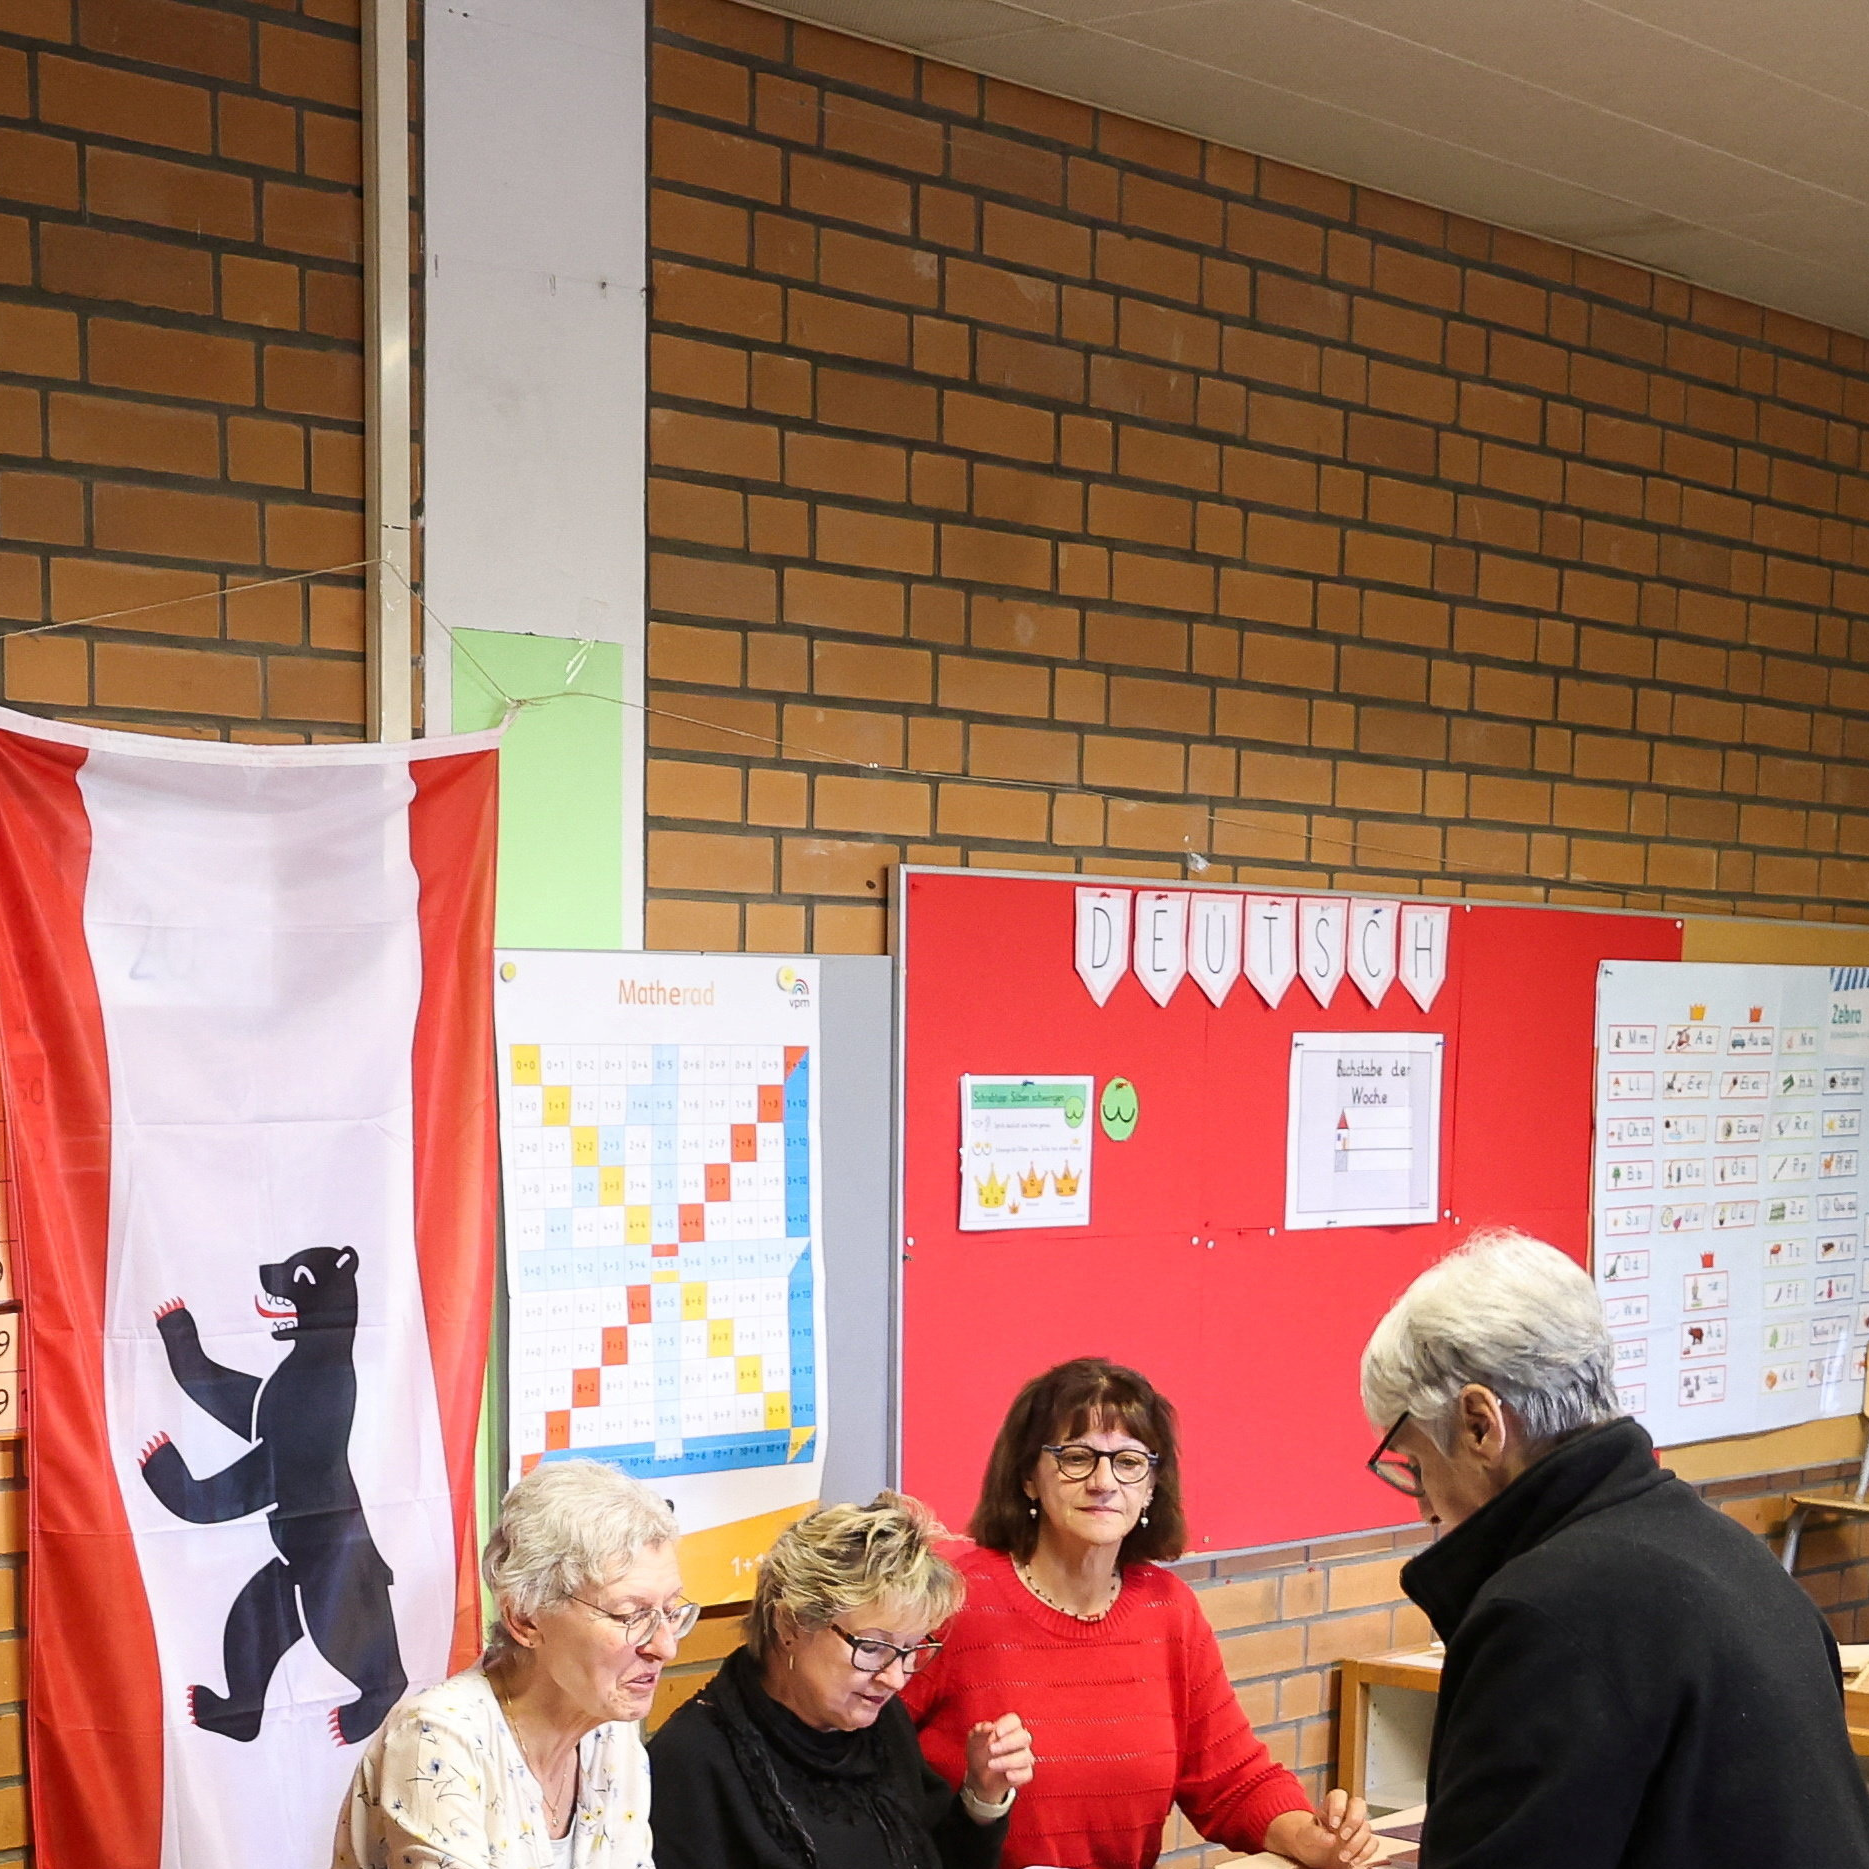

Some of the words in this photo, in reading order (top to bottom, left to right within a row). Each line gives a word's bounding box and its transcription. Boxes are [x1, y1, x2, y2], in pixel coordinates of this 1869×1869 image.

[1092, 906, 1435, 980] DEUTSCH
[619, 979, 715, 1006] Matherad
[1337, 1059, 1382, 1077] Buchstabe
[1391, 1060, 1411, 1077] der
[1352, 1087, 1387, 1105] Woche
